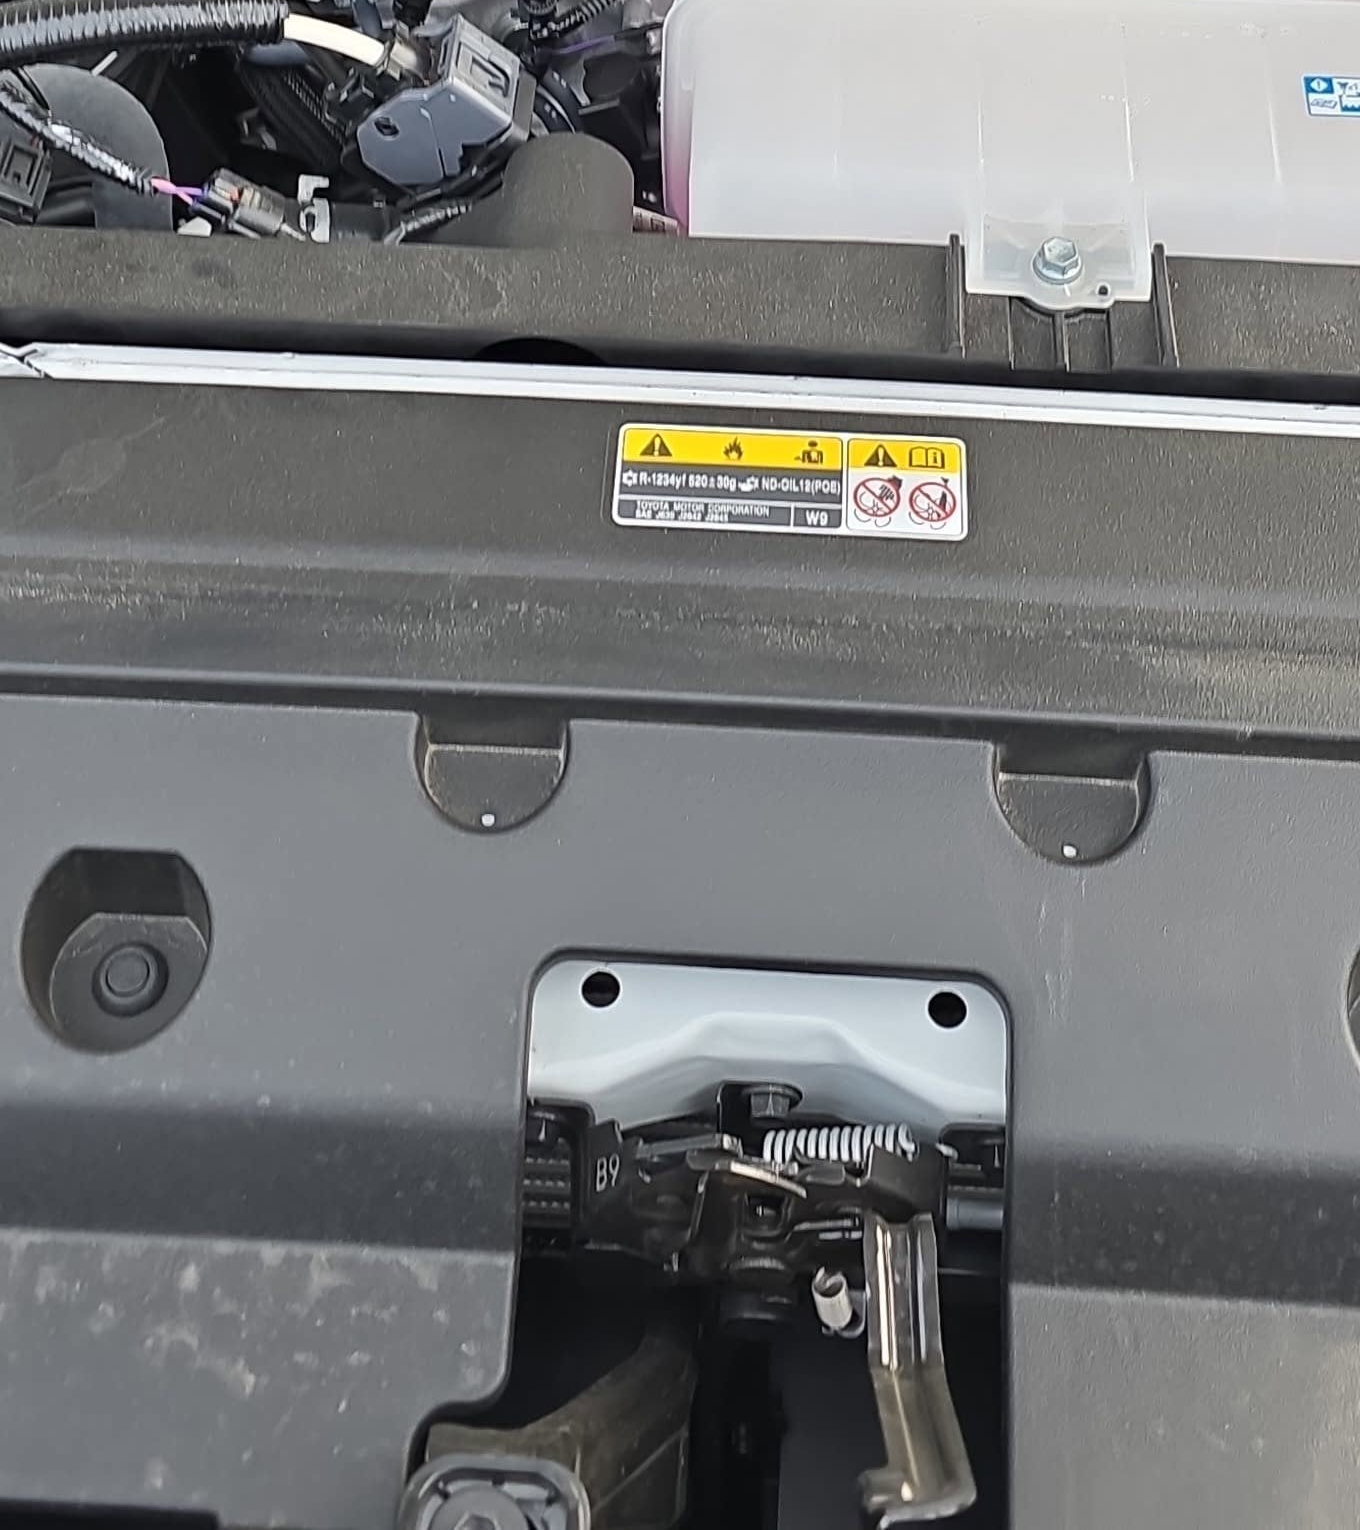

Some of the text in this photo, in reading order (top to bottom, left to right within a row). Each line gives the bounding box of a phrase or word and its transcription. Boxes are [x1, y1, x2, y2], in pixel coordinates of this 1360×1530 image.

[639, 470, 686, 490] R-1234yf
[635, 500, 770, 517] TOYOTA MOTOR CORPORATION
[805, 509, 829, 526] W9
[596, 1153, 620, 1192] B9
